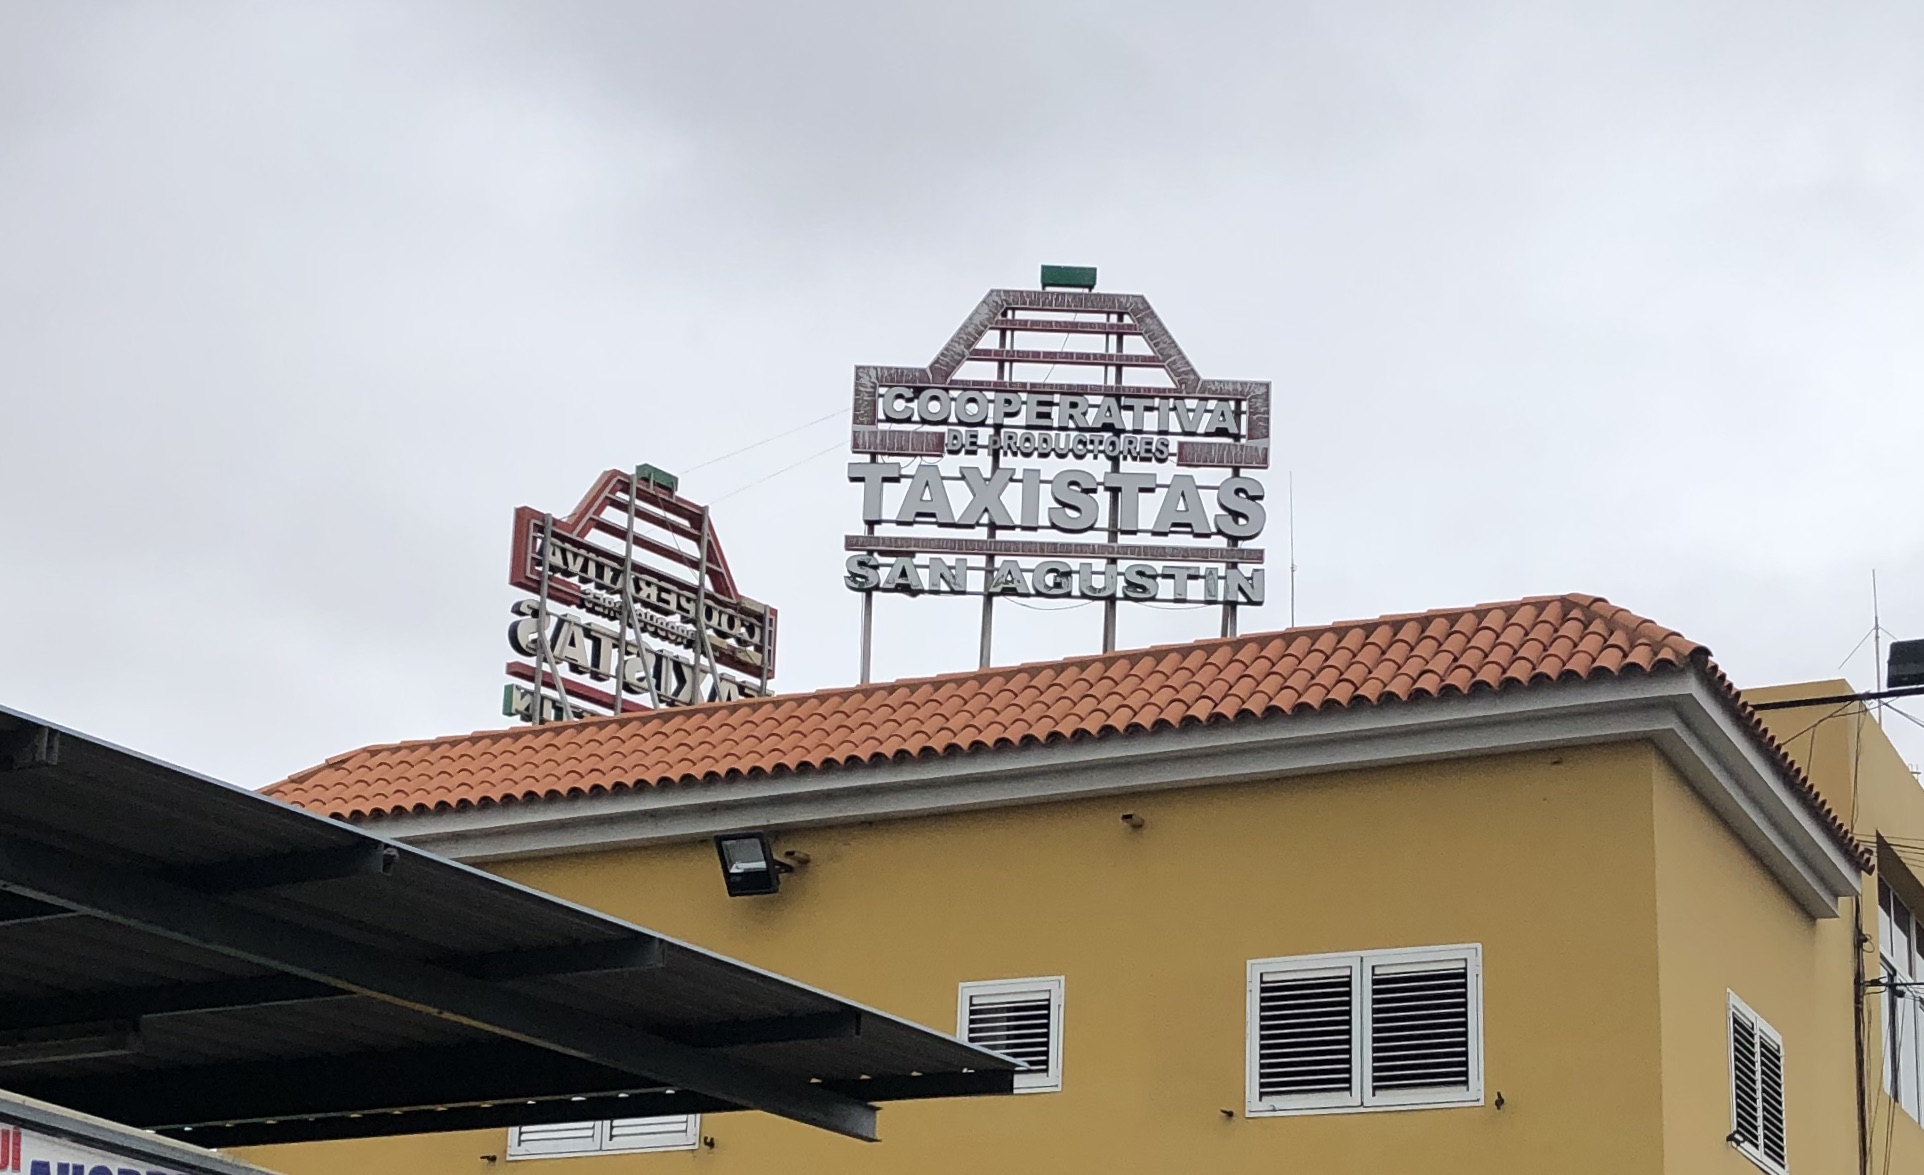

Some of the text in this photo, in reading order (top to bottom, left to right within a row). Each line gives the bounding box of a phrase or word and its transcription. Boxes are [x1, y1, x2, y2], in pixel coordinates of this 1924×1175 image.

[882, 387, 1239, 435] COOPERATIVA
[947, 428, 1170, 462] DE PRODUCTORES
[848, 462, 1266, 538] TAXISTAS
[844, 554, 1265, 605] SAN AGUSTIN
